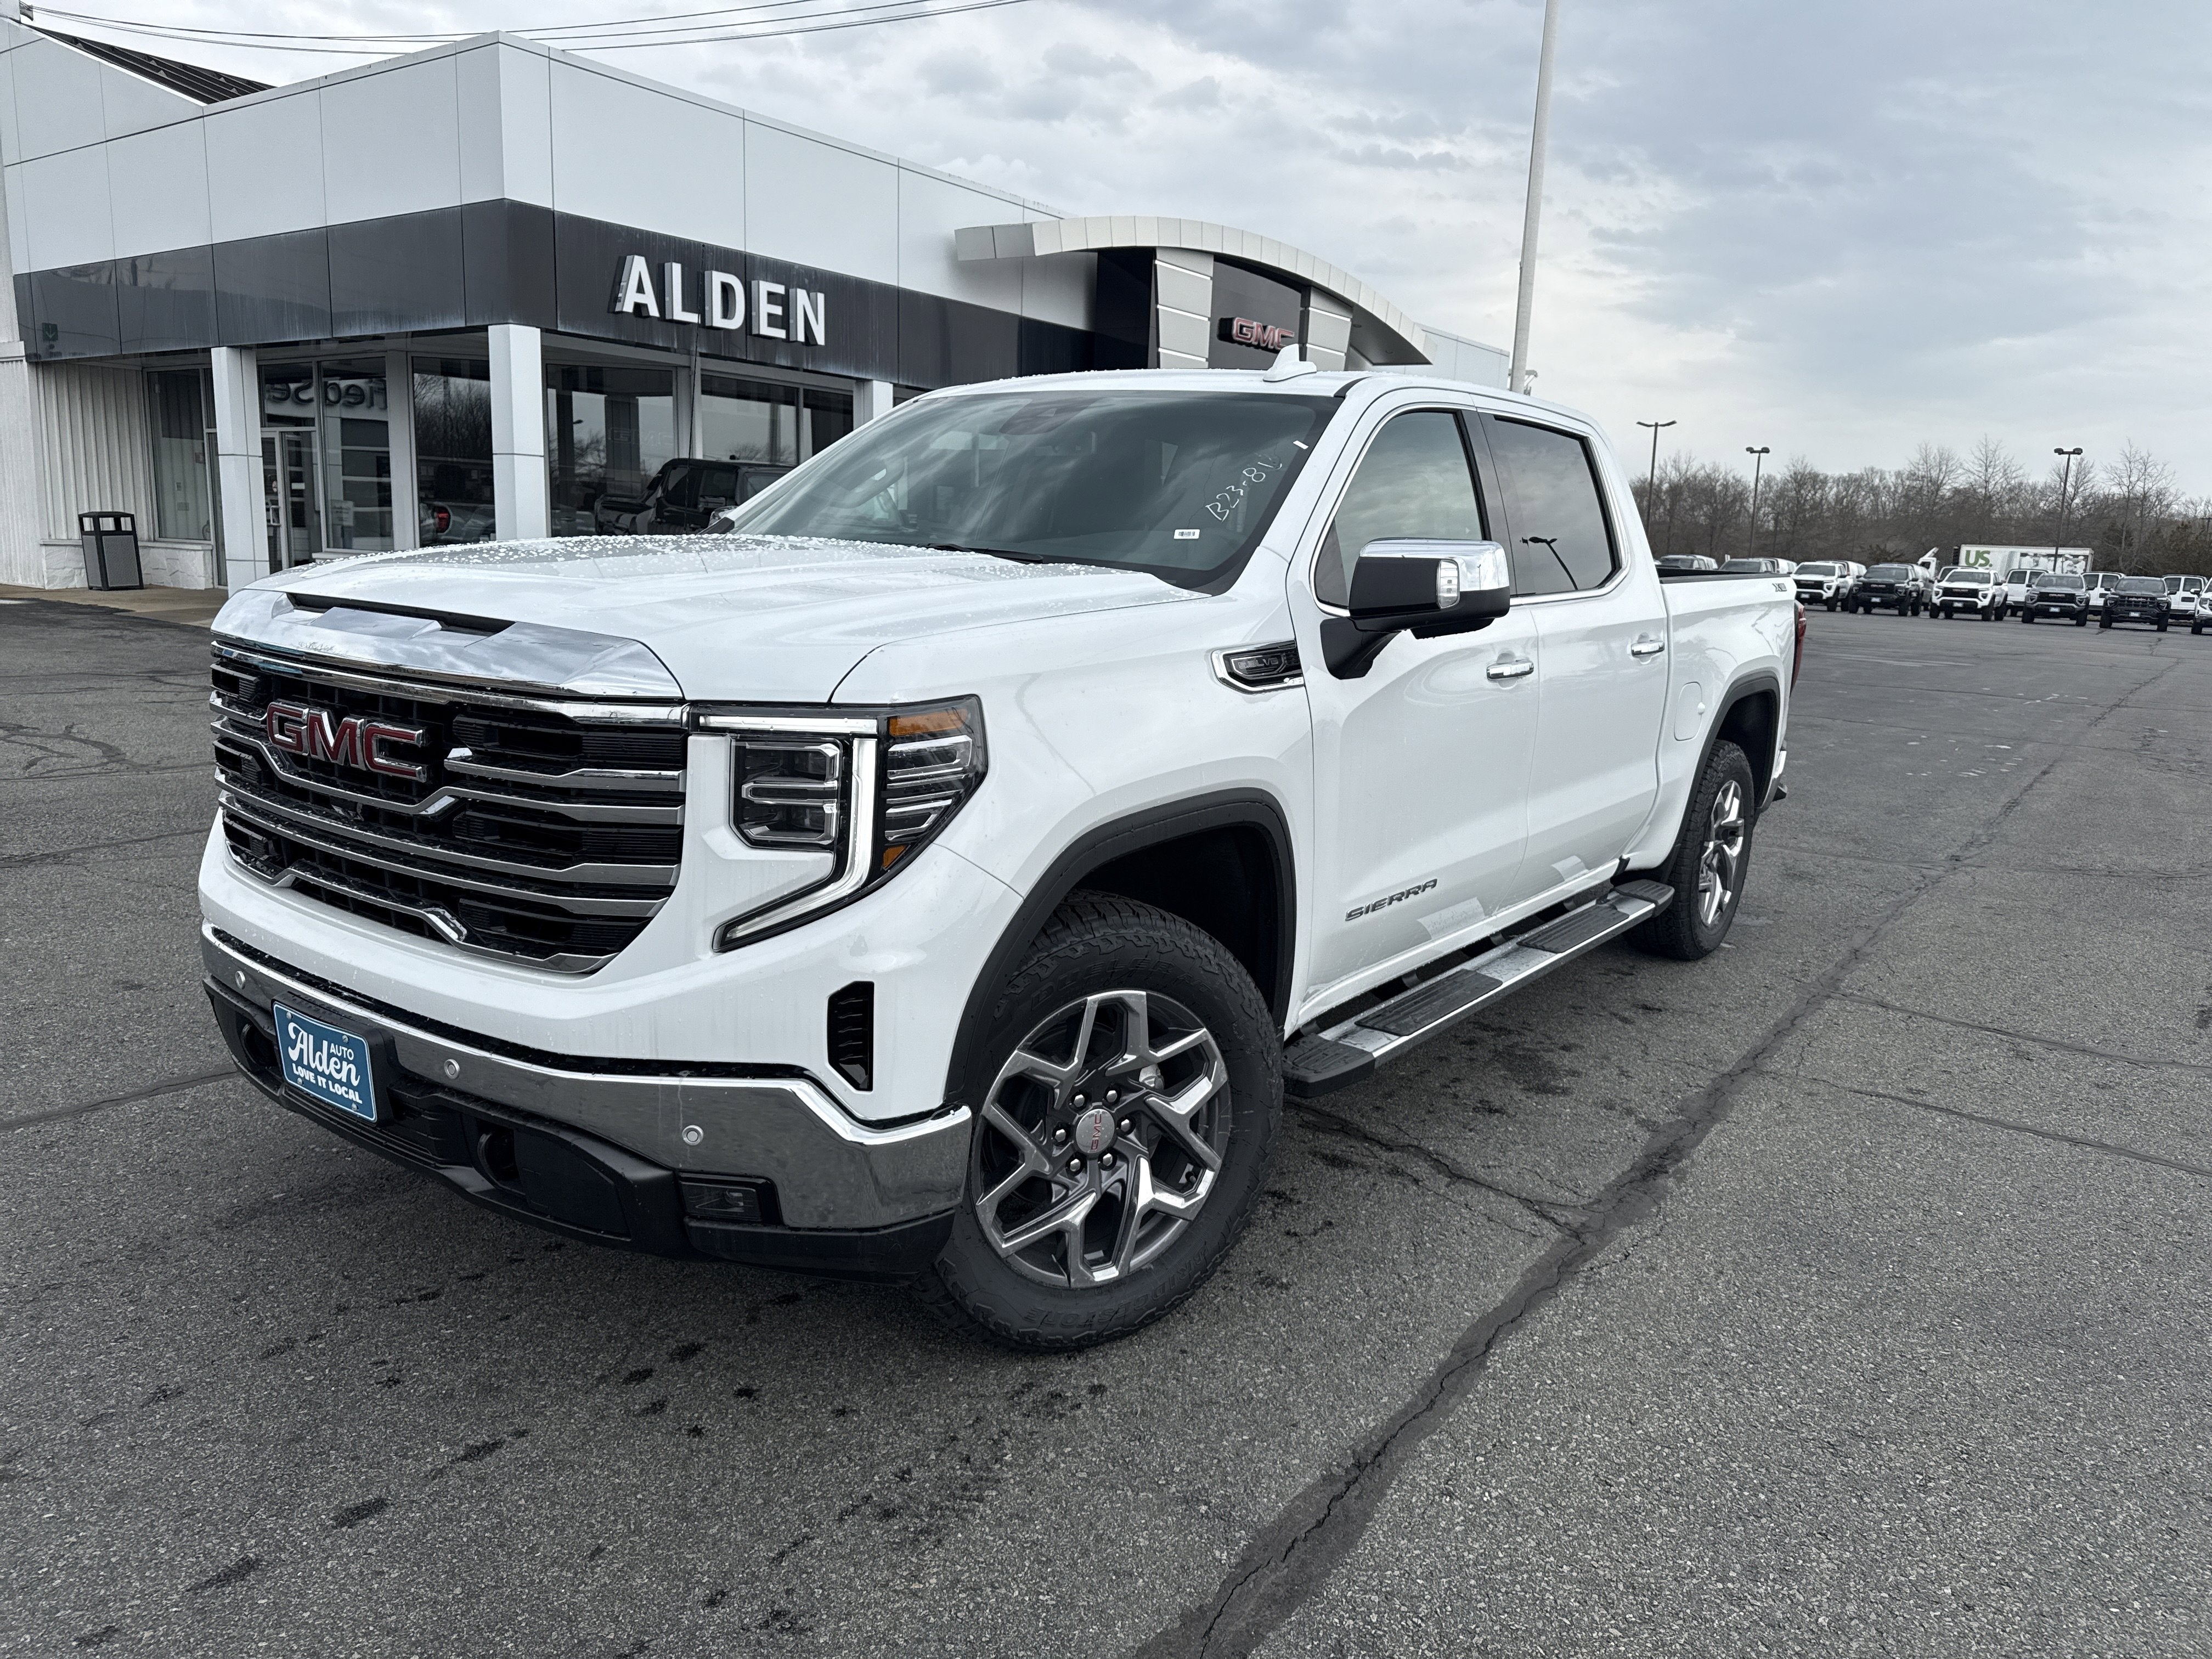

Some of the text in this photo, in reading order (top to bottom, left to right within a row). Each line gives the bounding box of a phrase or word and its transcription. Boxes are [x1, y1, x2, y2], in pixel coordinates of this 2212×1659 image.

[616, 255, 825, 346] ALDEN
[1232, 317, 1295, 350] GMC
[267, 702, 427, 783] GMC
[1345, 878, 1438, 921] SIERRA
[287, 1022, 360, 1087] Alden
[330, 1043, 354, 1060] AUTO
[292, 1063, 363, 1104] LOVE IT LOCAL
[1091, 1113, 1102, 1150] GMC
